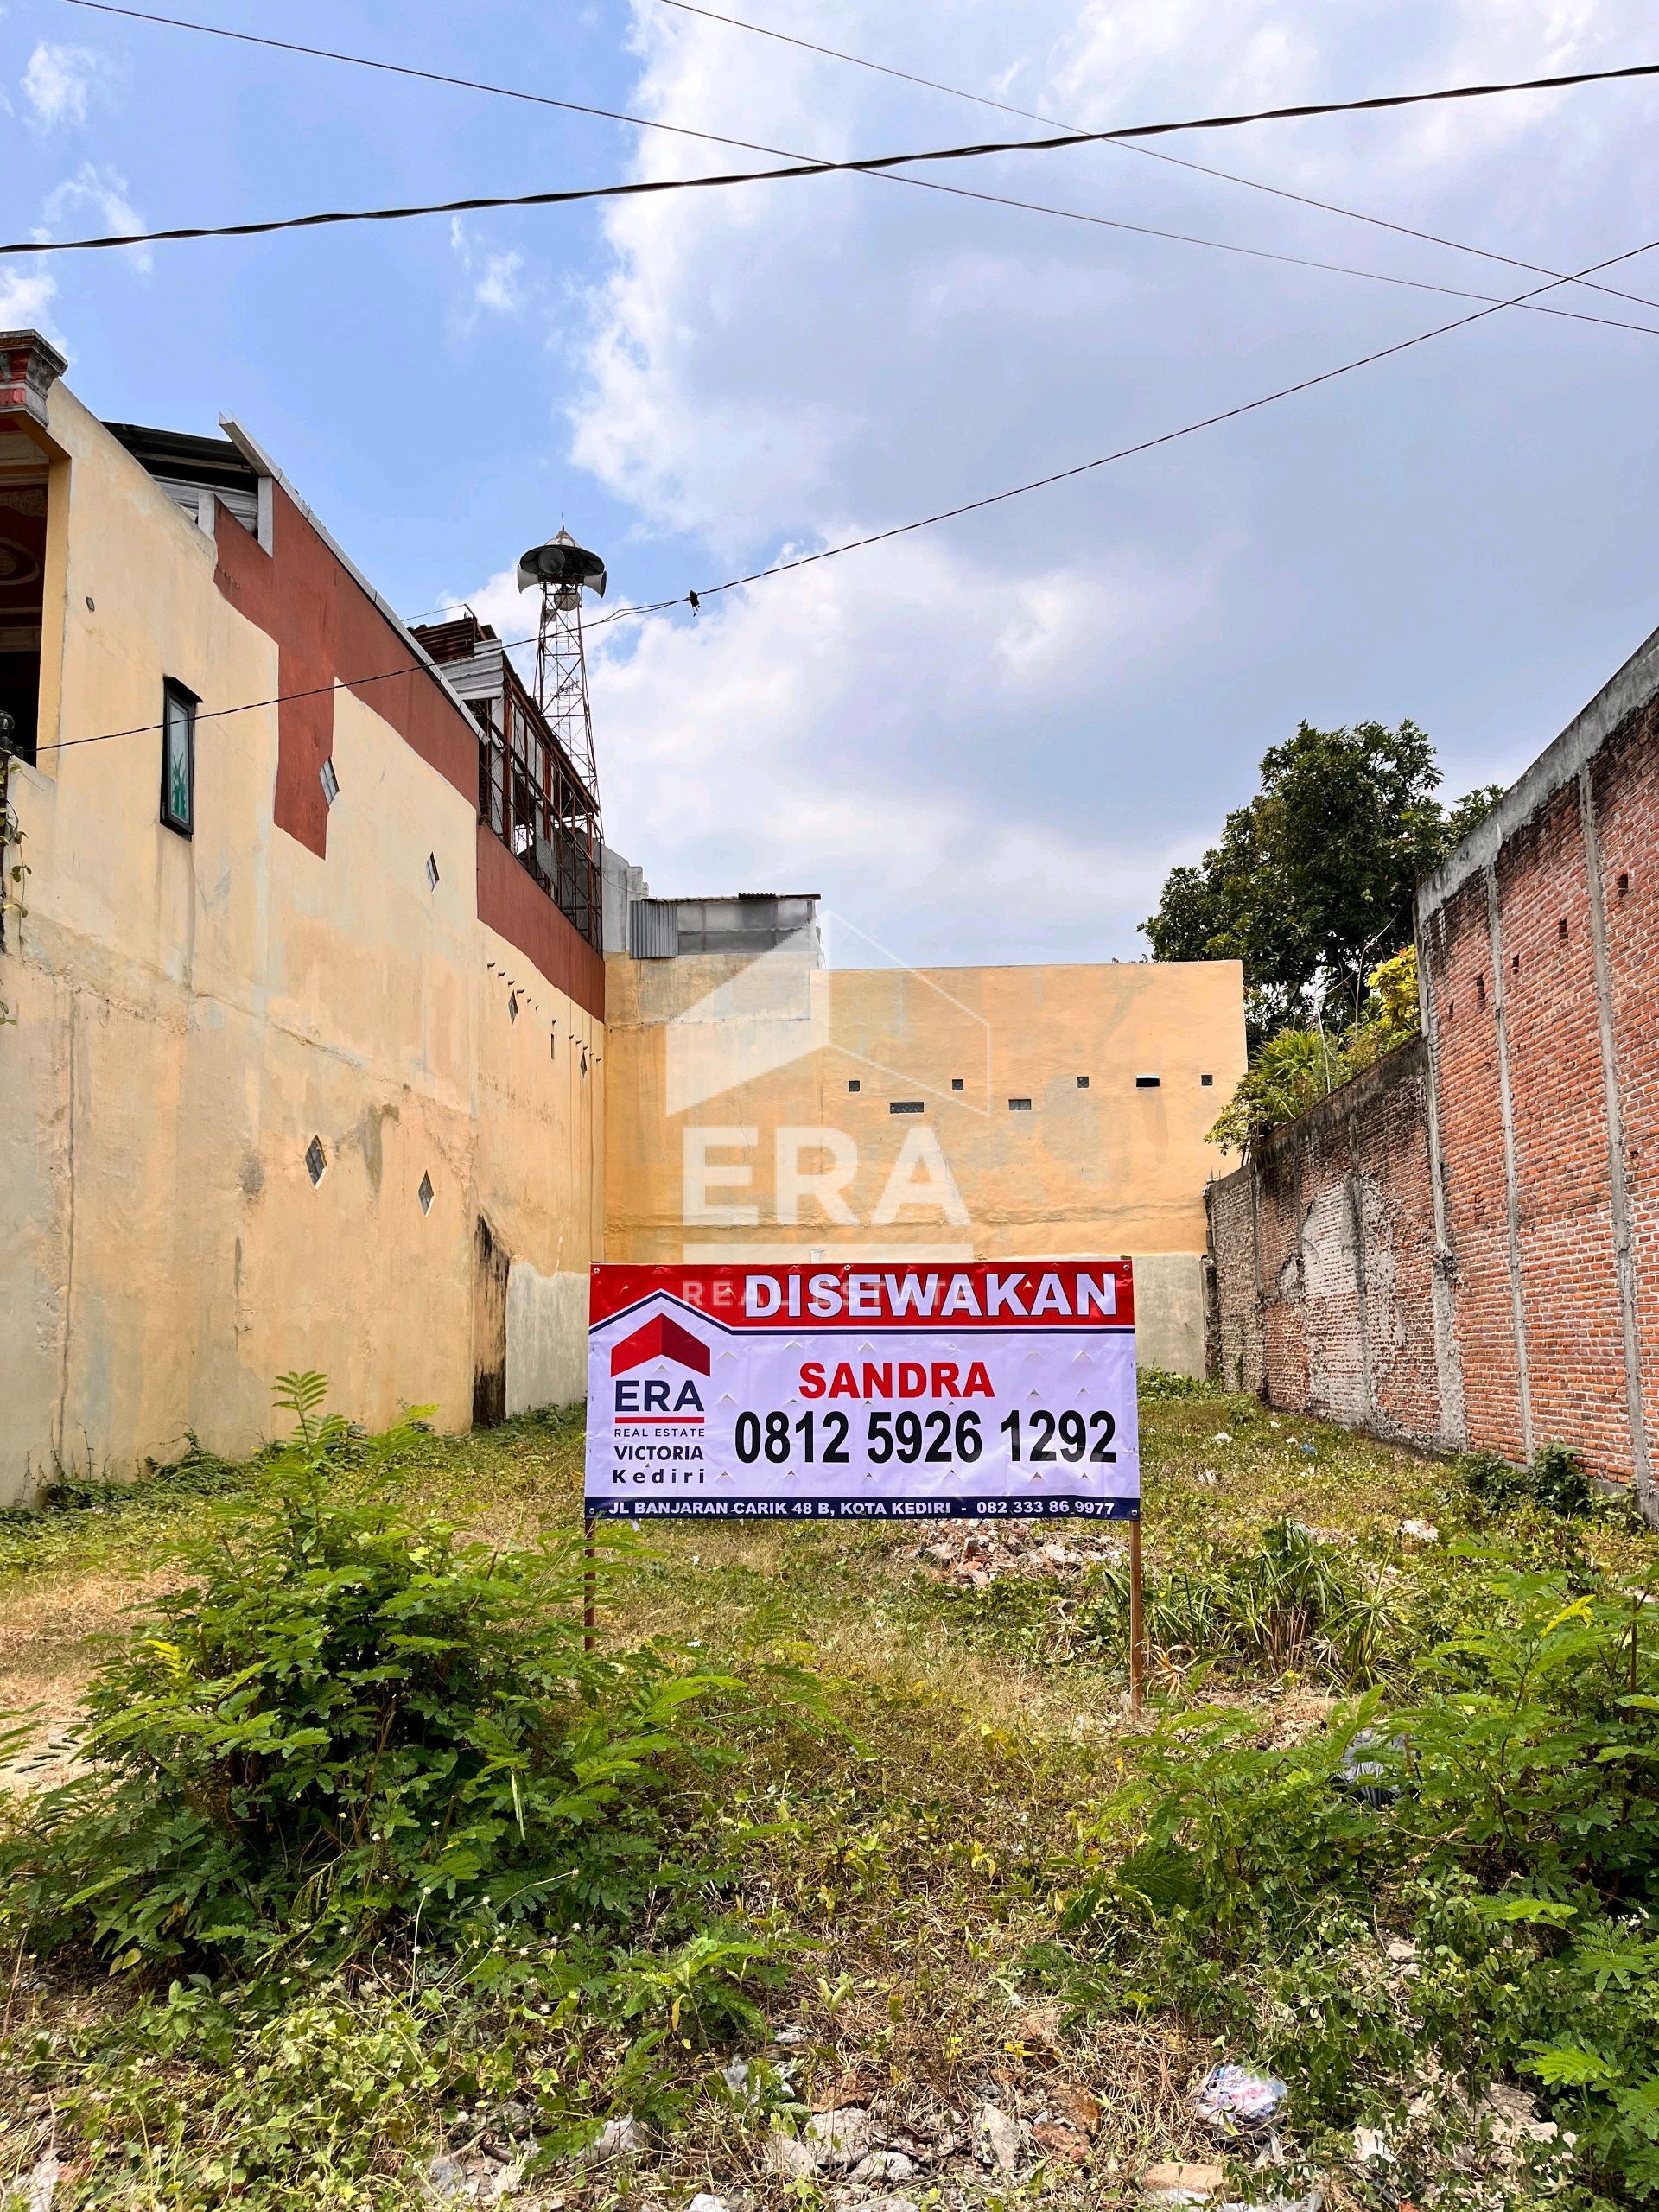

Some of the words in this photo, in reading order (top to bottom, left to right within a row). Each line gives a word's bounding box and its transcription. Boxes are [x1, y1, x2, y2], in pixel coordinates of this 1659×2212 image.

[744, 1273, 1117, 1319] DISEWAKAN
[798, 1362, 995, 1398] SANDRA
[614, 1380, 705, 1412] ERA
[614, 1428, 648, 1437] REAL
[655, 1428, 705, 1437] ESTATE
[734, 1410, 849, 1463] 0812
[866, 1410, 982, 1463] 5926
[1001, 1409, 1116, 1463] 1292
[613, 1446, 704, 1460] VICTORIA
[613, 1468, 704, 1484] Kediri
[608, 1502, 630, 1514] JL
[634, 1502, 728, 1514] BANJARAN
[734, 1502, 787, 1514] CARIK
[792, 1502, 812, 1514] 48
[818, 1502, 835, 1516] B,
[840, 1502, 886, 1514] KOTA
[892, 1503, 950, 1514] KEDIRI
[976, 1501, 1008, 1514] 082
[1013, 1501, 1044, 1513] 333
[1049, 1501, 1070, 1512] 86
[1075, 1502, 1115, 1515] 9977
